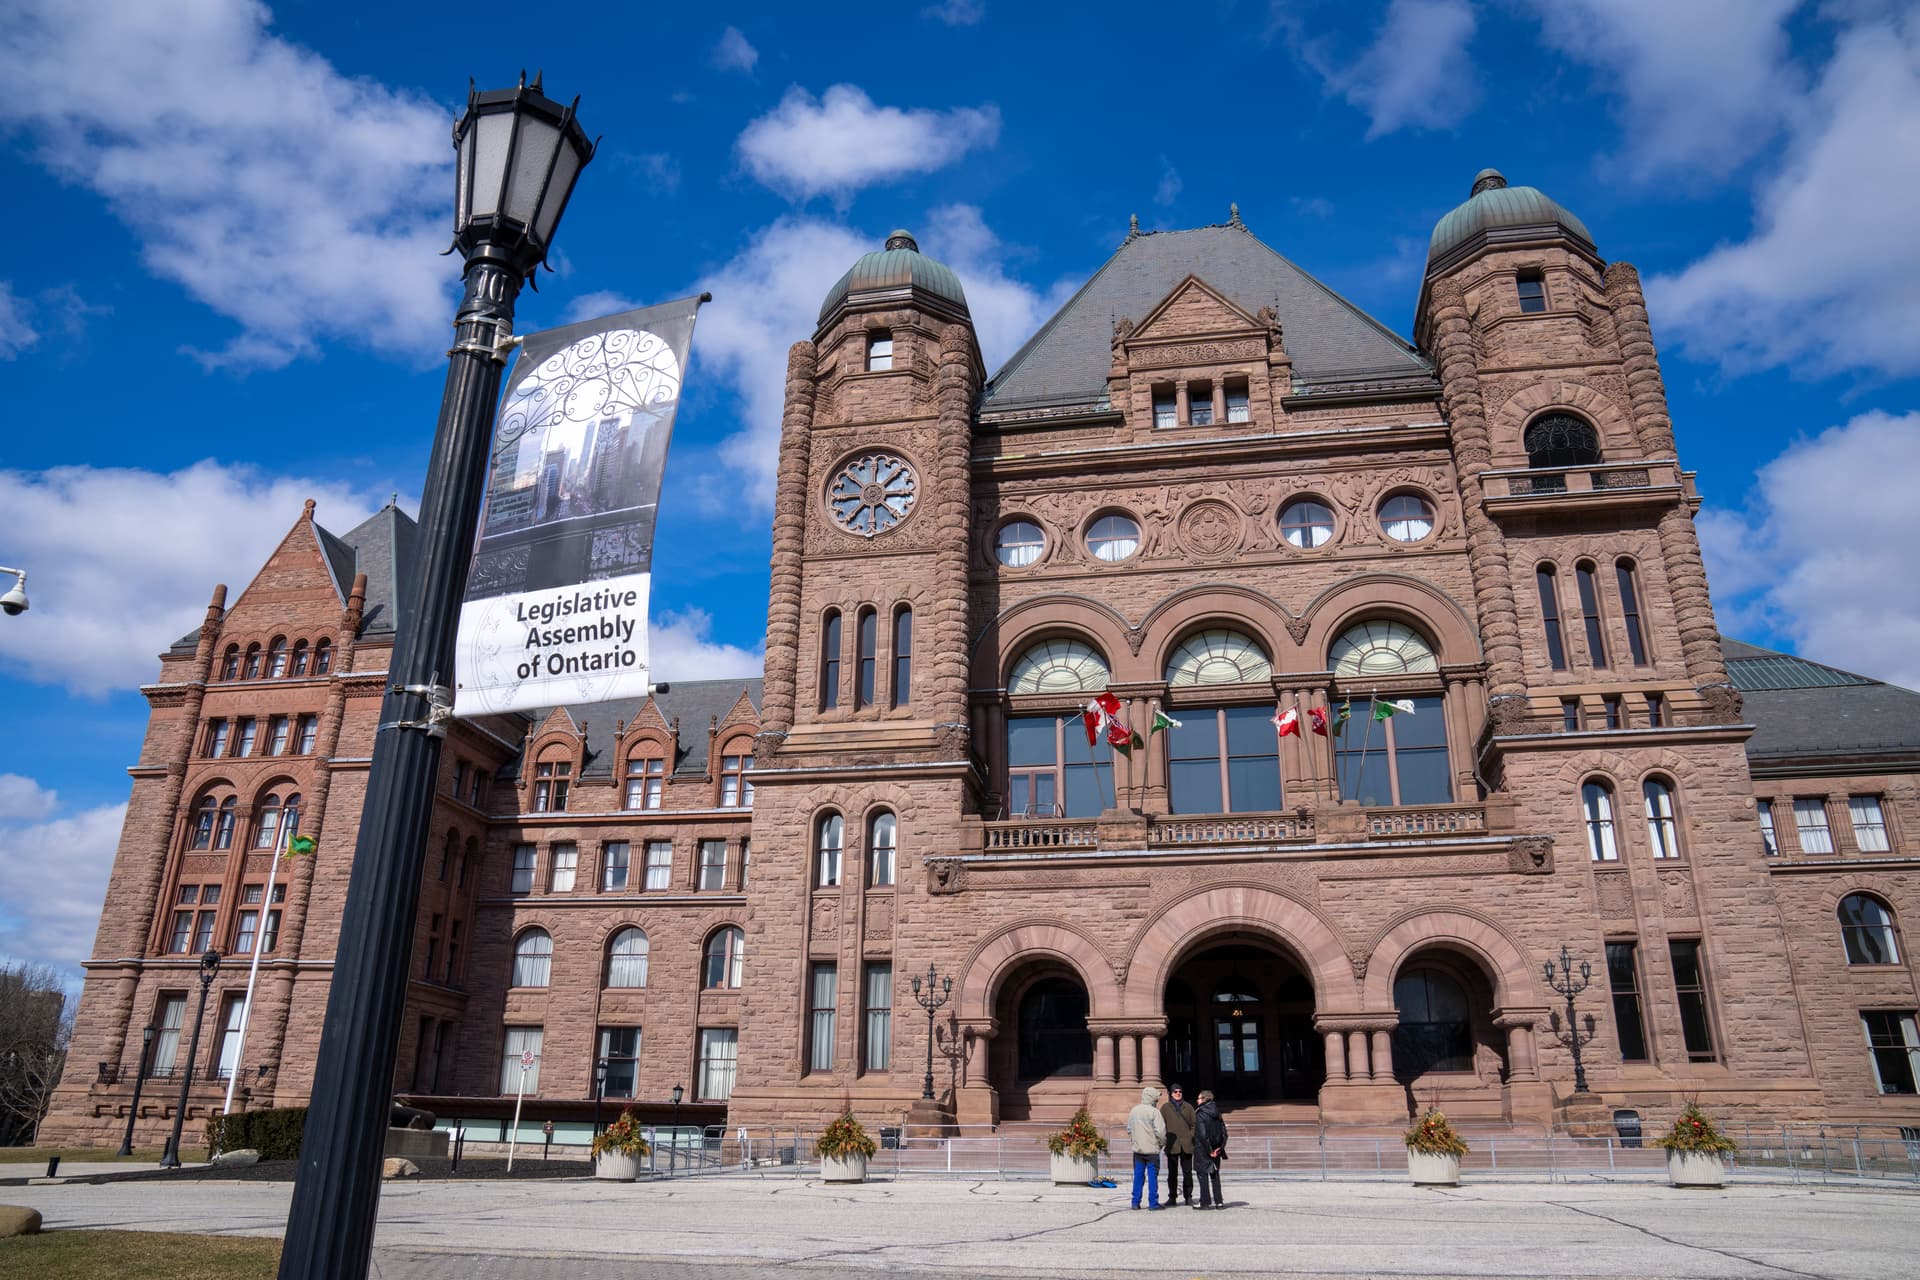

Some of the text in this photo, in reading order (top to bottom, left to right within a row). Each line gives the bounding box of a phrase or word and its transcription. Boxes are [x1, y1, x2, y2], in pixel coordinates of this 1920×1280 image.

[517, 588, 637, 624] Legislative
[525, 614, 636, 649] Assembly
[517, 645, 636, 679] of Ontario
